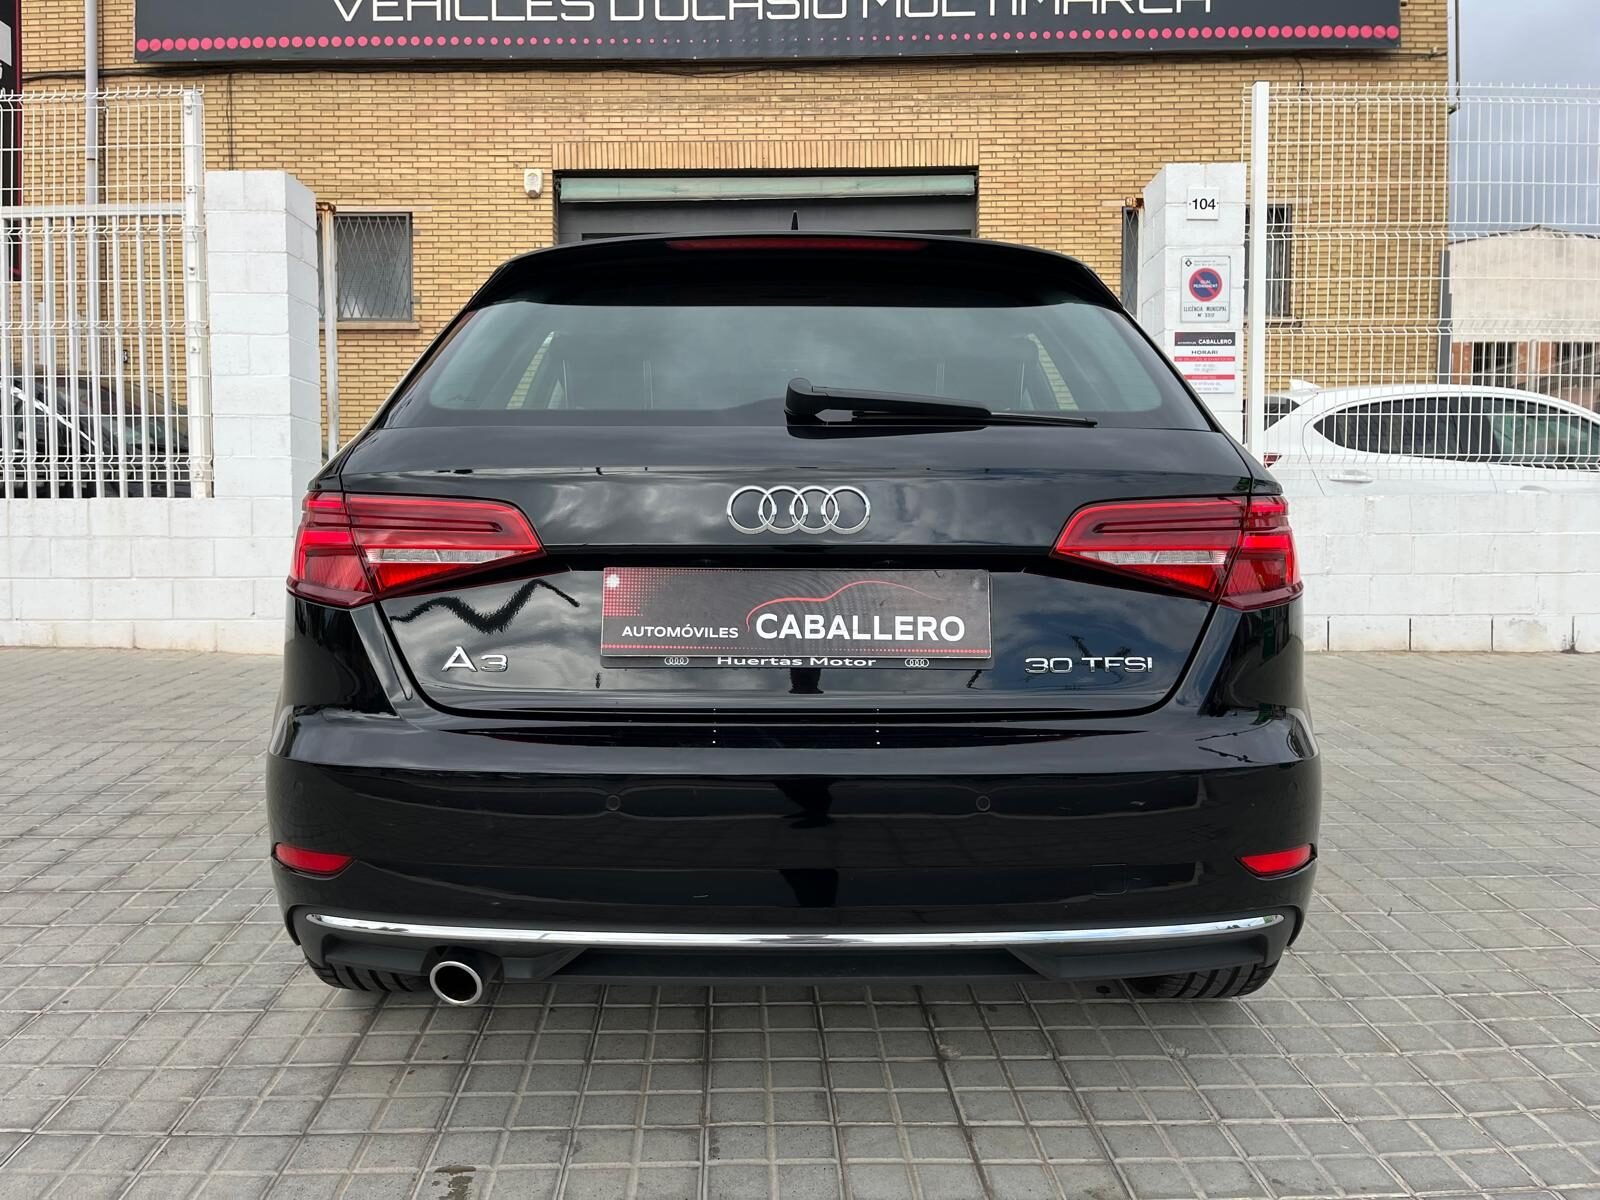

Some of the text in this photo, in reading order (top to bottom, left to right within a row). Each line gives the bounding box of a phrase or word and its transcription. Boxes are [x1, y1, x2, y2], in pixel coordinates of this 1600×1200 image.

[334, 0, 595, 21] VEHICLES
[1191, 198, 1216, 210] 104
[622, 613, 965, 642] AUTOMÓVILES CABALLERO
[441, 645, 508, 672] A3
[717, 656, 877, 667] Huertas Motor
[1024, 656, 1153, 673] 30 TFSI
